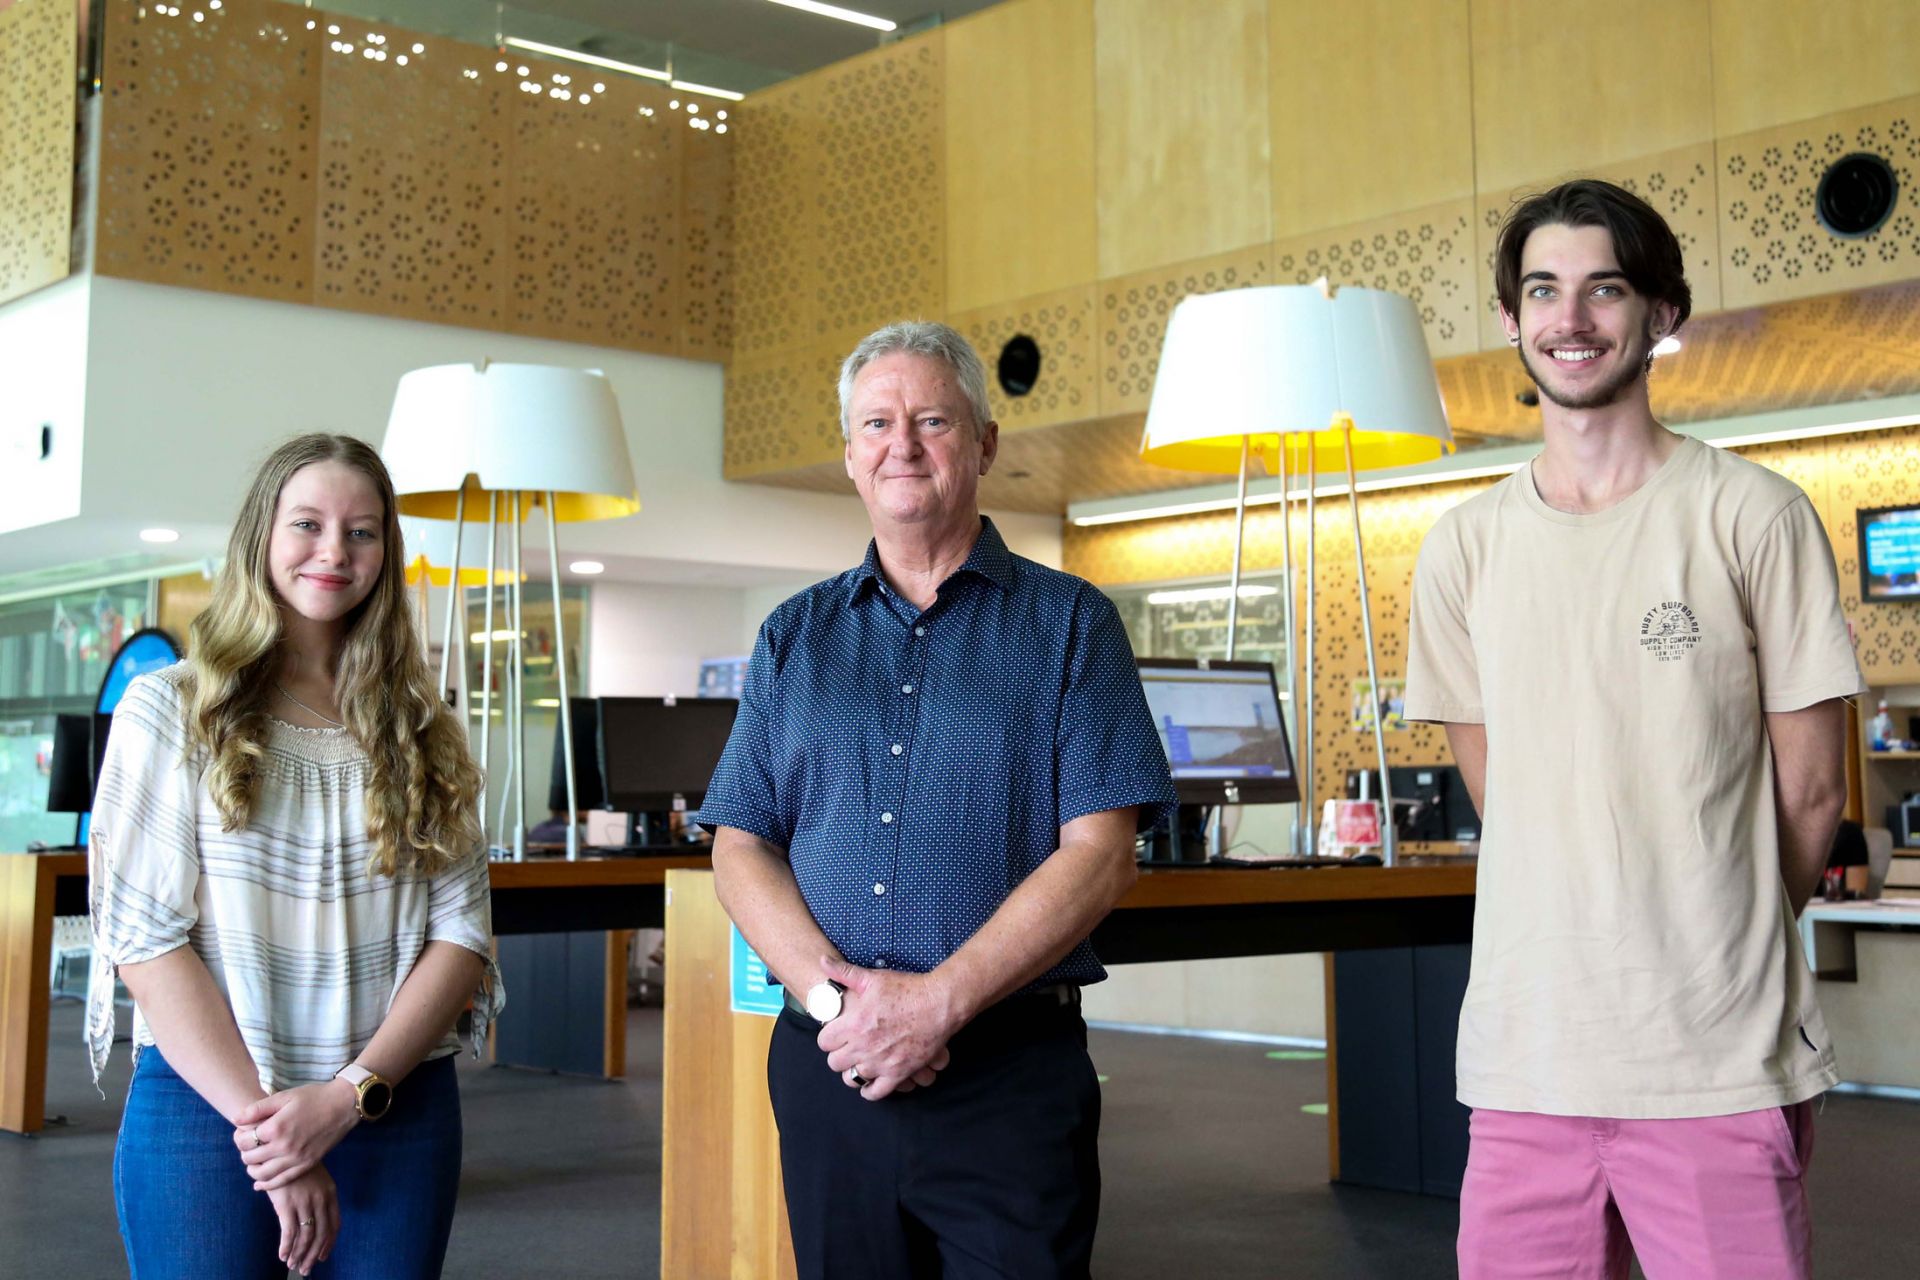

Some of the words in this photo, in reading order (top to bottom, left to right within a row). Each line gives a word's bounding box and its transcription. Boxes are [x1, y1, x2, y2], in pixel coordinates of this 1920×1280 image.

[1641, 607, 1658, 635] RUSTY
[1661, 601, 1699, 633] SURFBOARD
[1670, 636, 1702, 644] COMPANY
